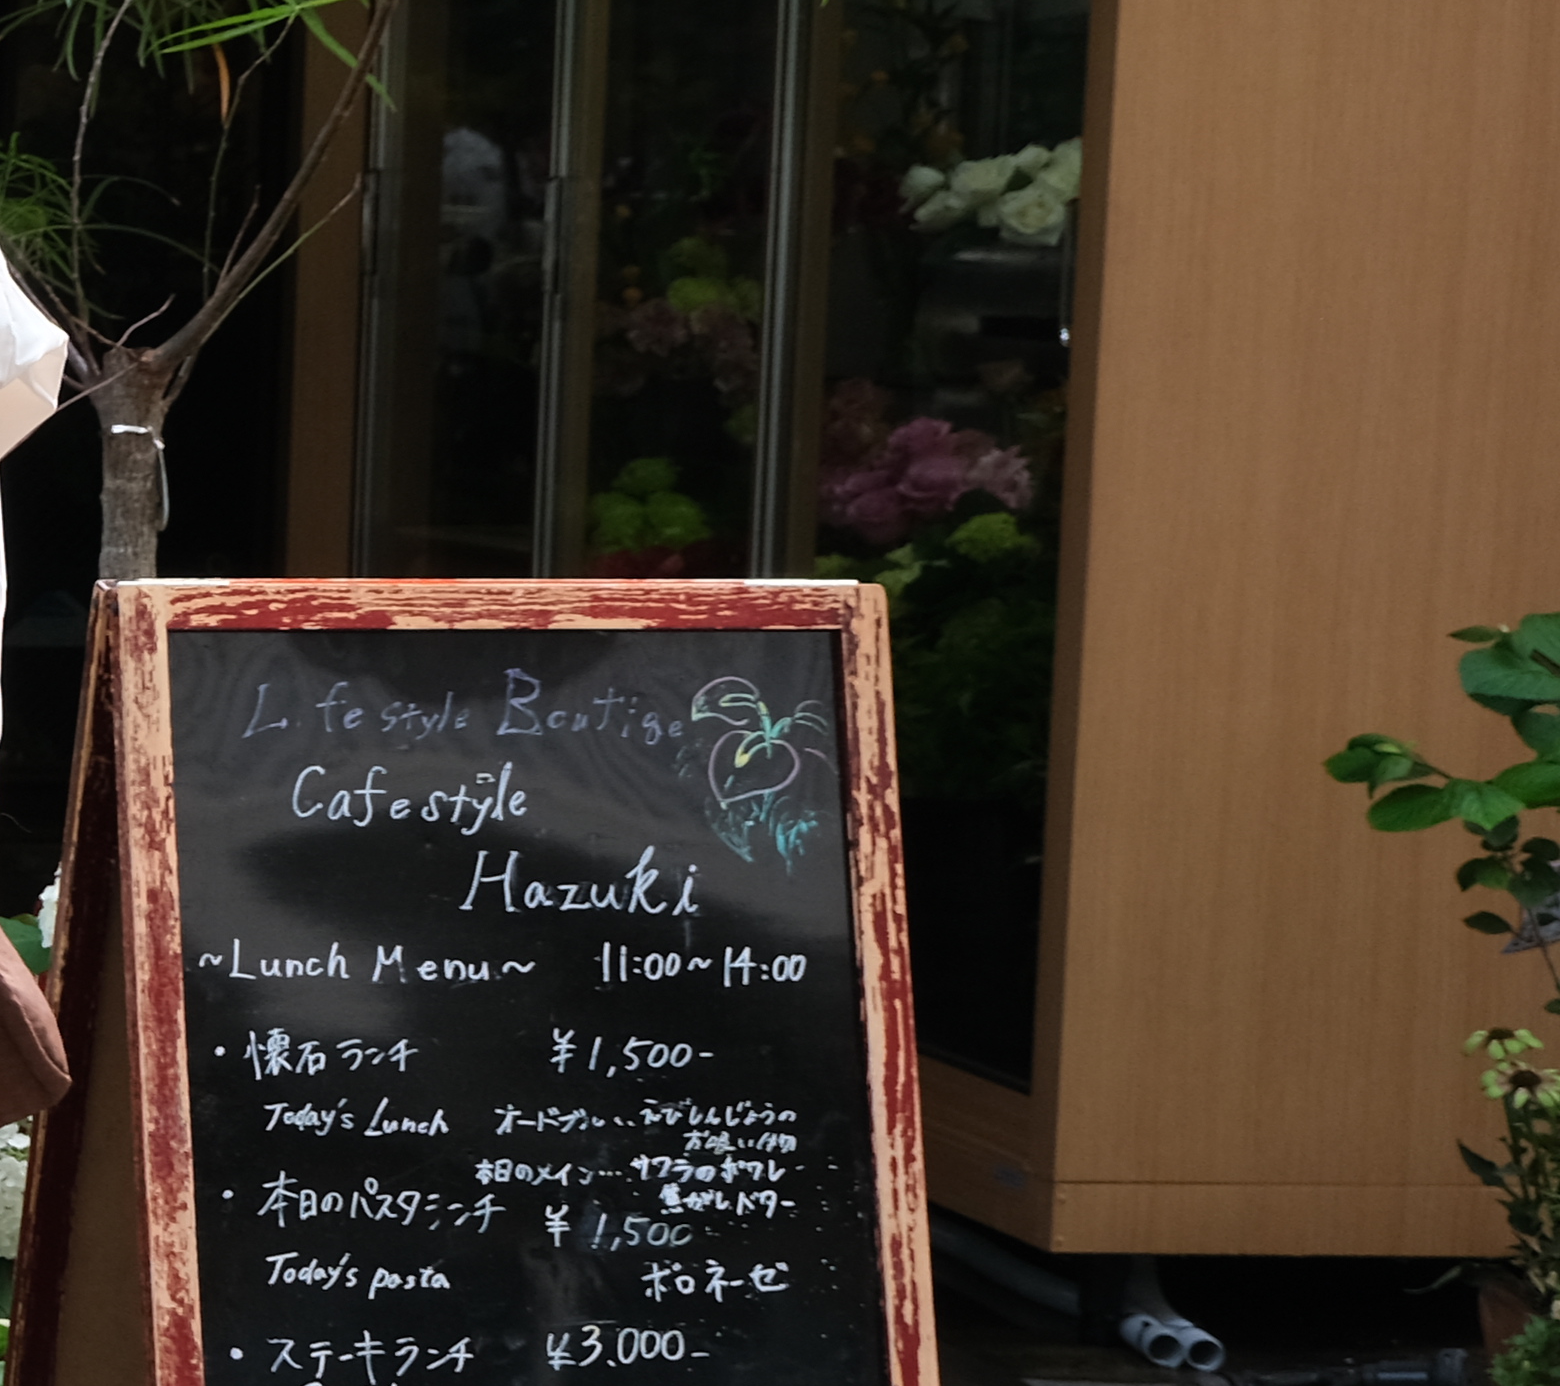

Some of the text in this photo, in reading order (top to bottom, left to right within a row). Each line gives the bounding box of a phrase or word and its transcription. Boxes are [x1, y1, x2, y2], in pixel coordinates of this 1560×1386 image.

[458, 844, 700, 916] Hazuki
[263, 1096, 450, 1138] Today's Lunch
[265, 1251, 451, 1300] Today's pasta
[266, 1329, 475, 1386] ステーキランチ
